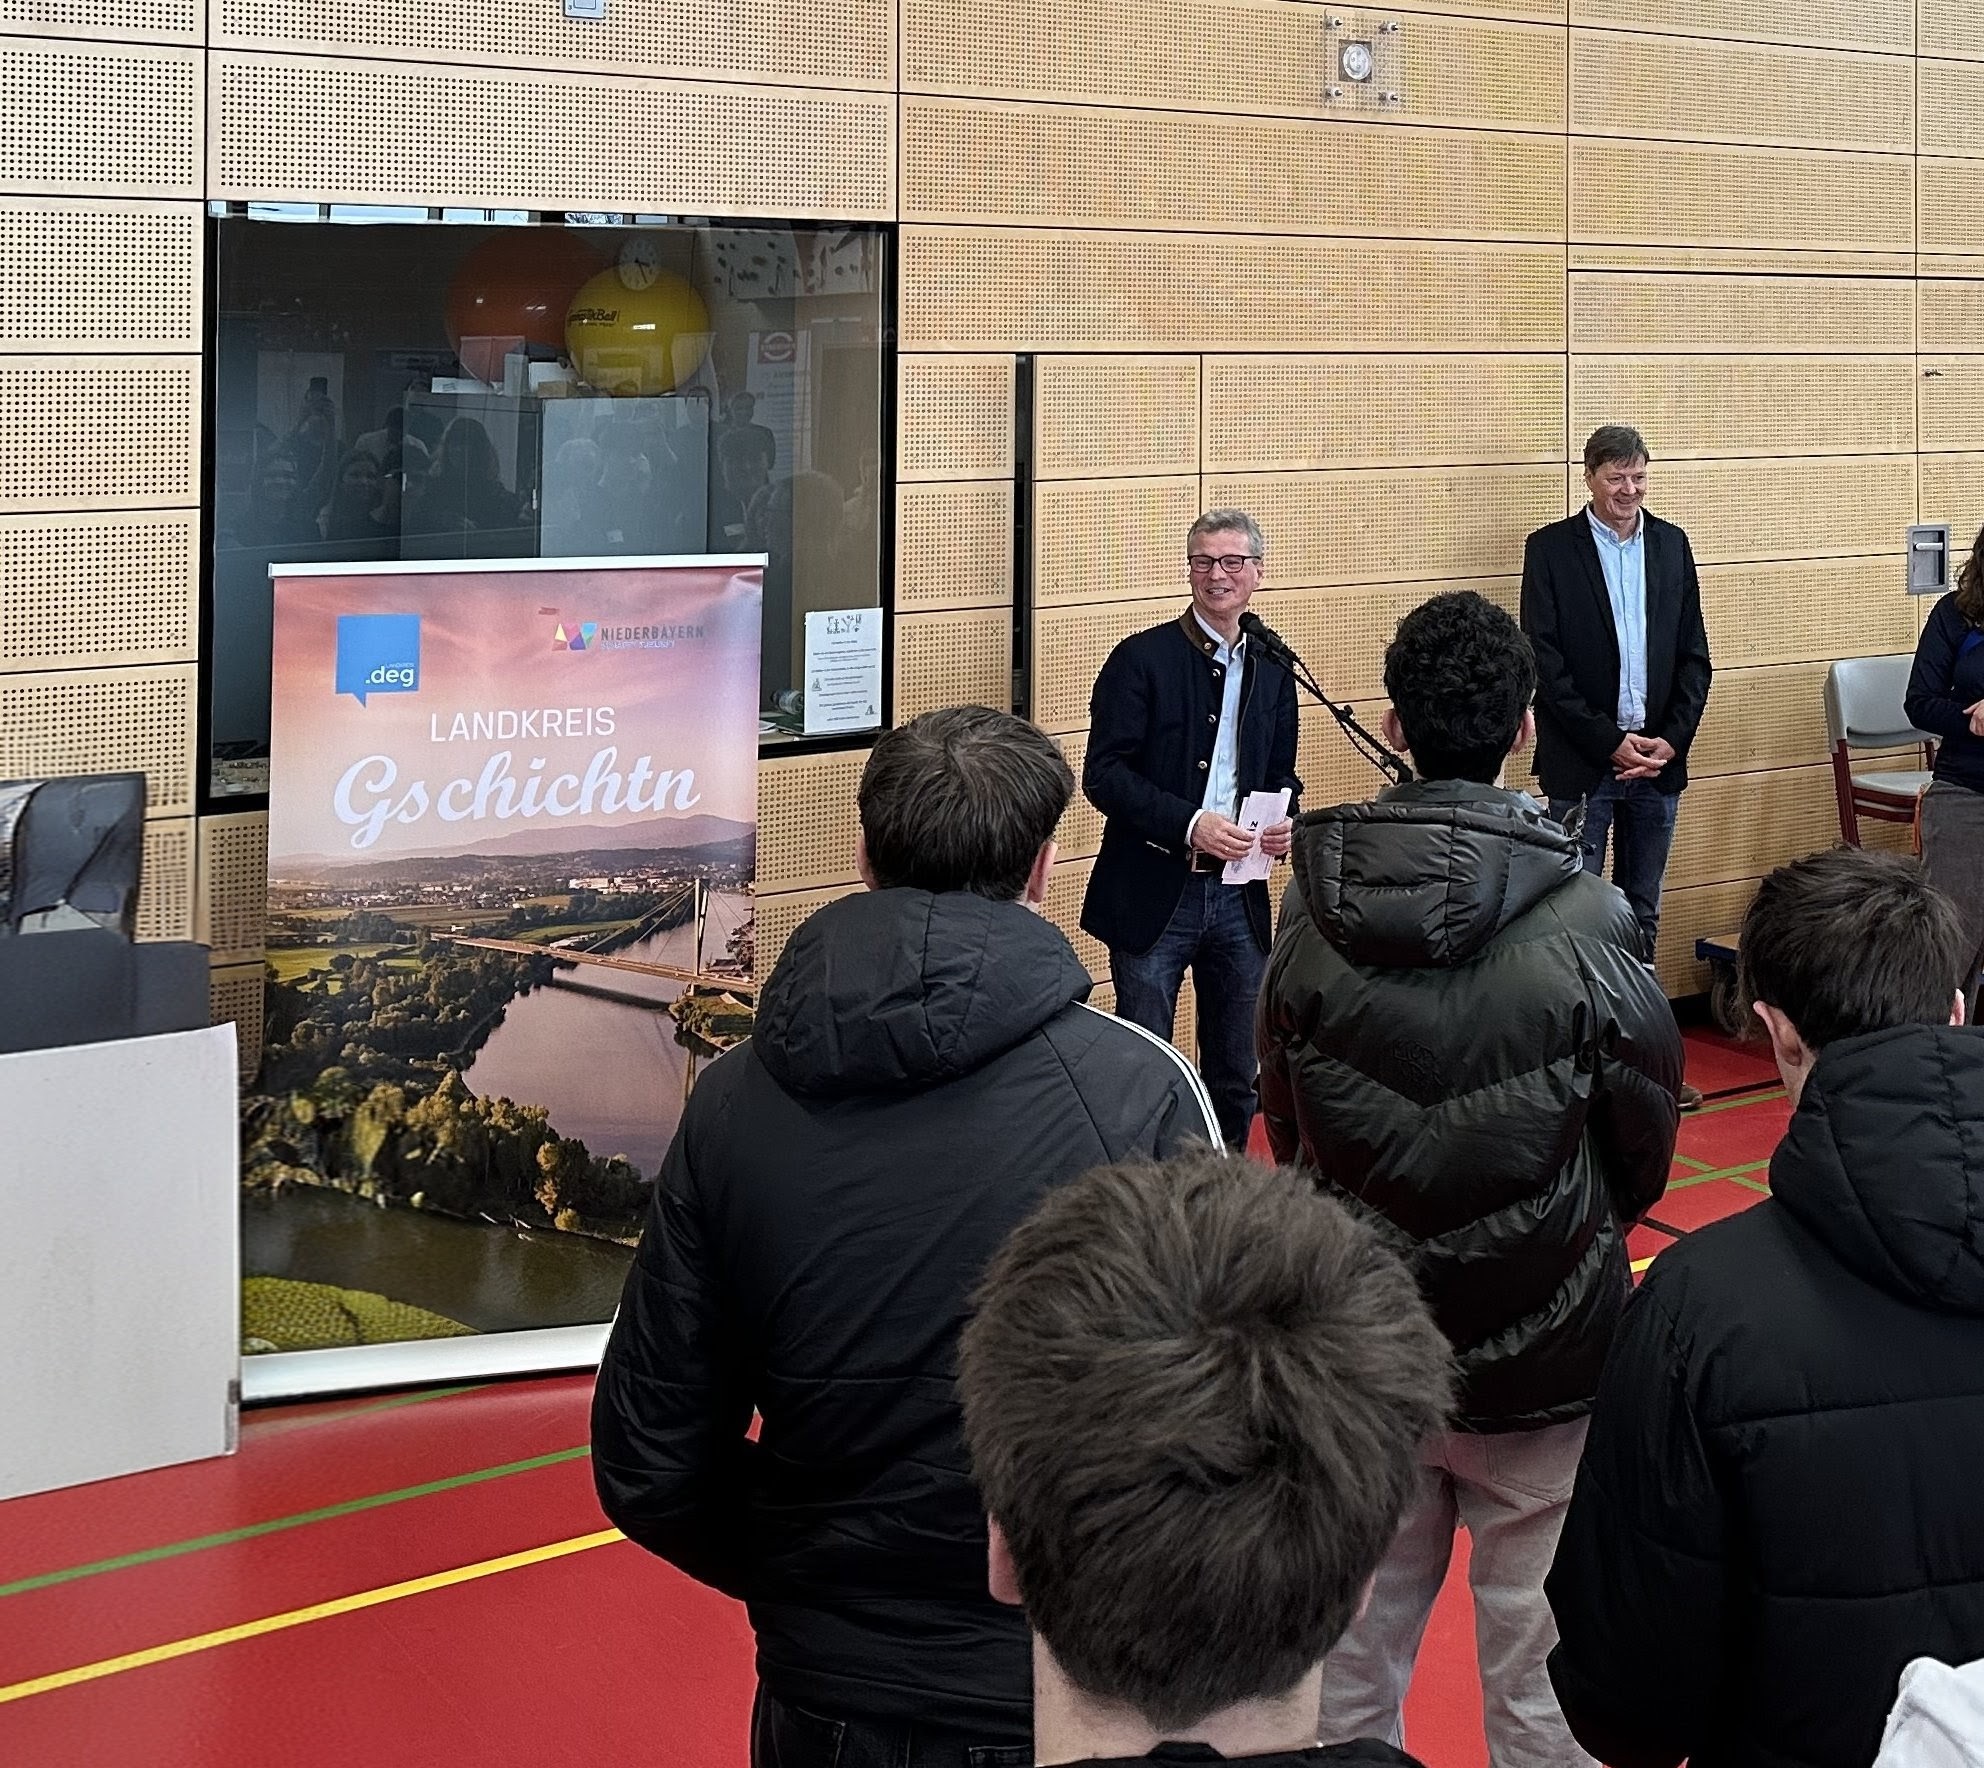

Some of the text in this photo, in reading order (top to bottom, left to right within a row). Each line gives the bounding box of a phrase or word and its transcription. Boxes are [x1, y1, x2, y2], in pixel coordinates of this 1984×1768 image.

[601, 625, 704, 641] NIEDERBAYERN
[365, 665, 414, 688] .deg
[430, 706, 616, 742] LANDKREIS
[333, 746, 701, 849] Gschichtn
